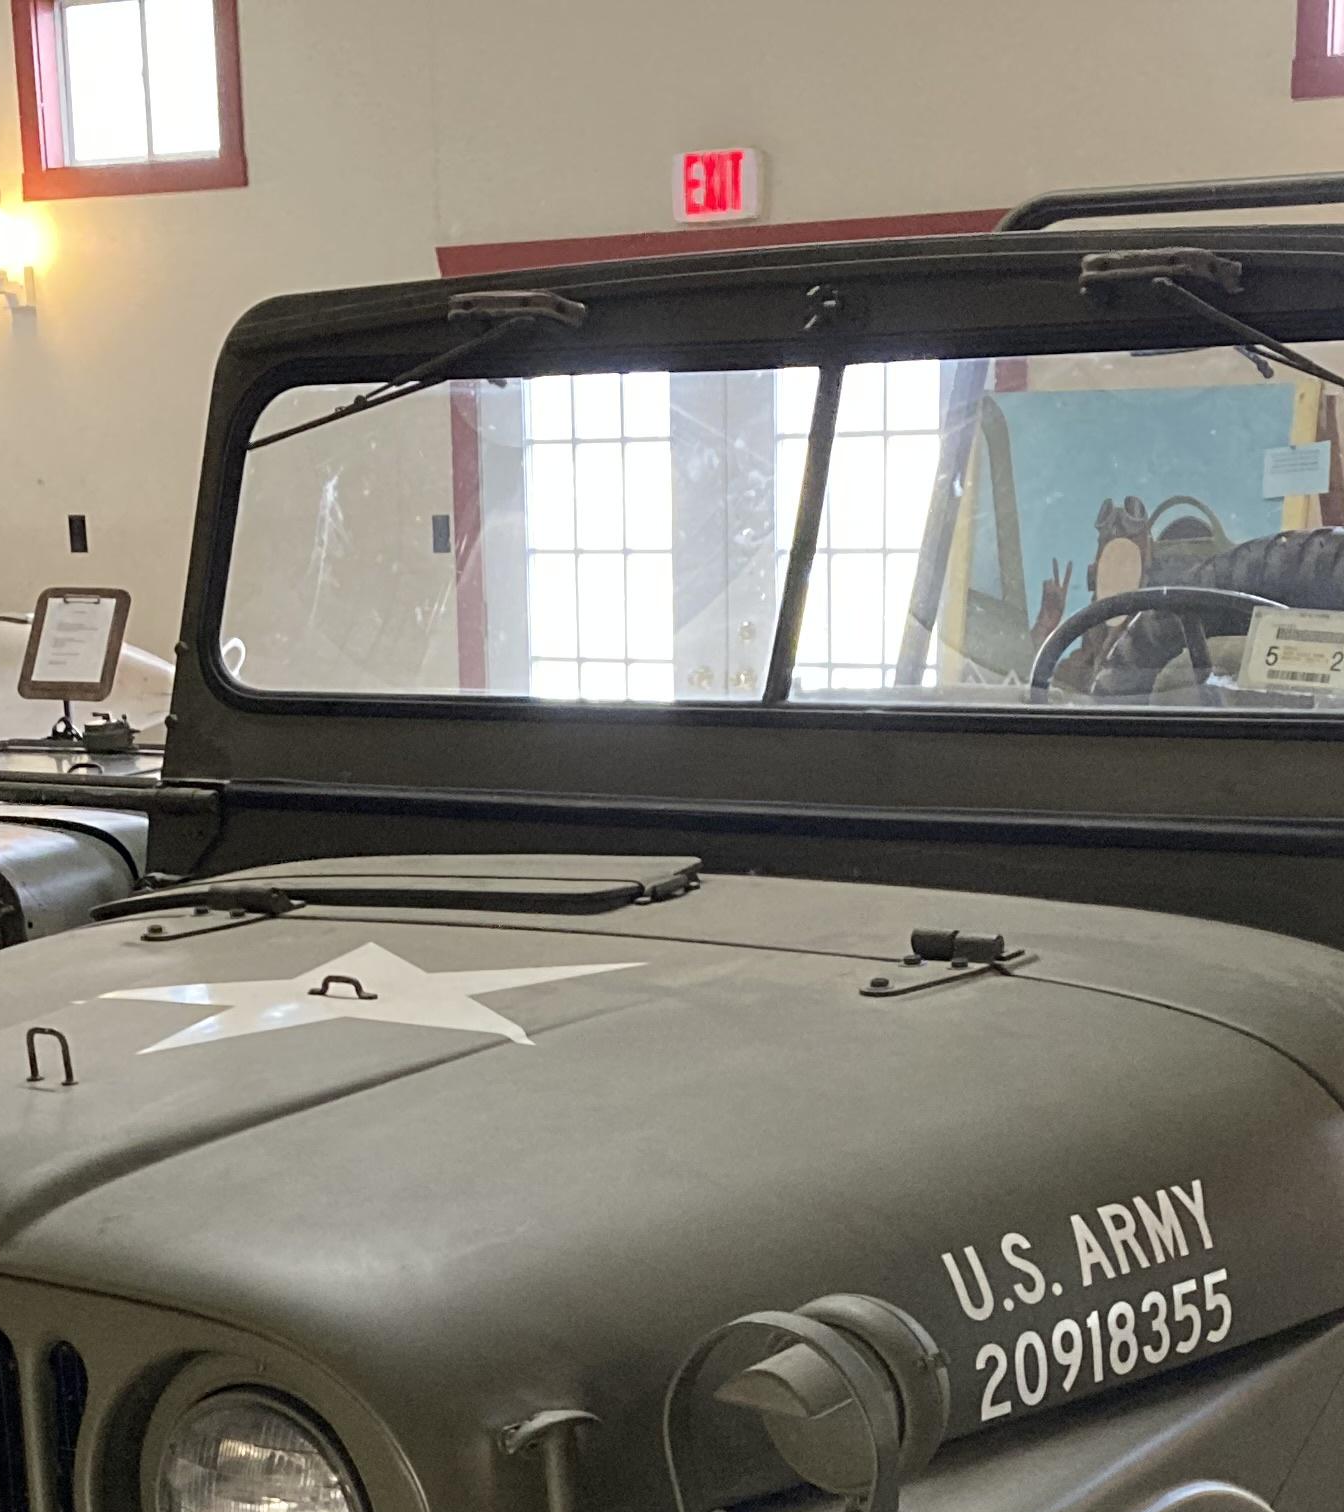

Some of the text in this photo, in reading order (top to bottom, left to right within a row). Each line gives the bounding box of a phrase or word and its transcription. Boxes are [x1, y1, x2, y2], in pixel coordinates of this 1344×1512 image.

[684, 150, 743, 215] EXIT
[1264, 645, 1279, 666] 5
[941, 1179, 1214, 1321] U.S. ARMY
[975, 1268, 1232, 1422] 20918355
